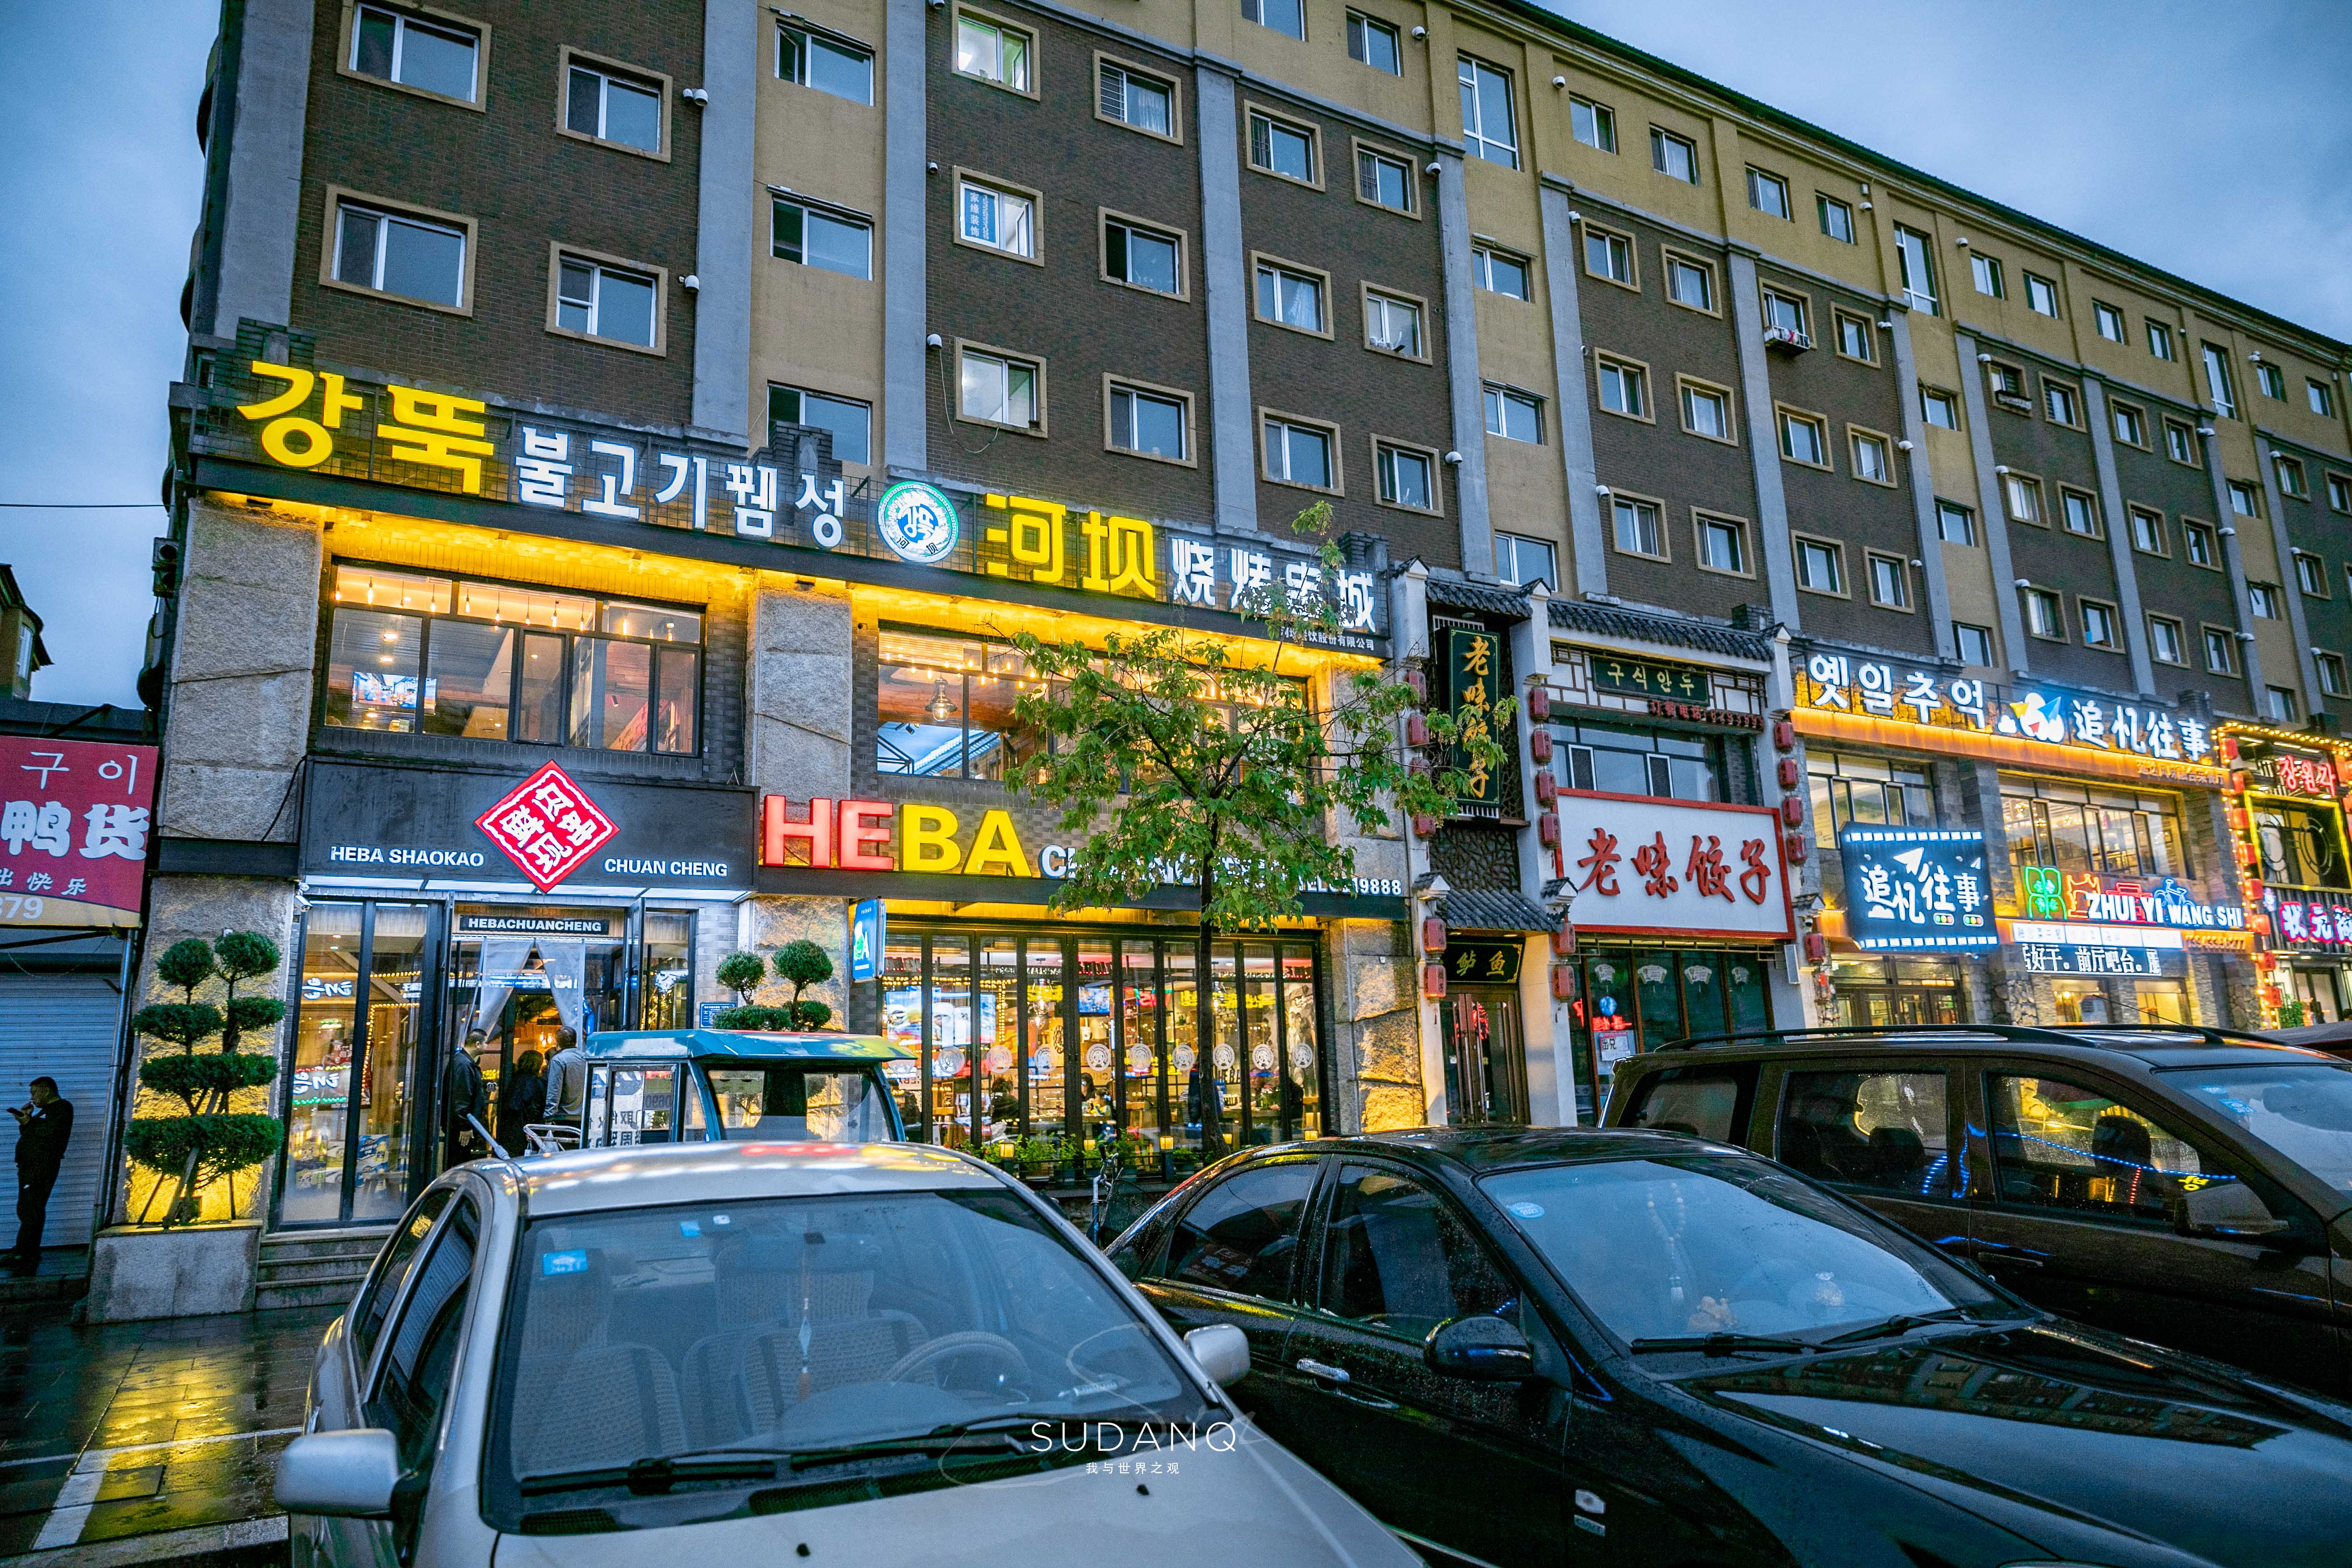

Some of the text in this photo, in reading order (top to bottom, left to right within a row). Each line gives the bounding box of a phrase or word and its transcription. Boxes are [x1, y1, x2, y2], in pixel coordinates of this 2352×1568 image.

[237, 361, 494, 495] 강뚝
[986, 493, 1156, 599] 河坝
[1808, 654, 2211, 762] 옛일추억 追忆往事
[21, 751, 139, 795] 구이
[2277, 754, 2337, 797] 장원각
[1, 800, 151, 861] 鸭货
[763, 794, 1032, 878] HEBA
[330, 846, 485, 868] HEBA SHAOKAO
[604, 858, 728, 877] CHUAN CHENG
[1577, 827, 1771, 905] 老味饺子
[0, 897, 44, 919] 79
[1860, 862, 1981, 924] 追忆往事
[2086, 893, 2244, 928] ZHUI YI WANG SHI
[468, 917, 602, 932] HEBACHUANCHENG
